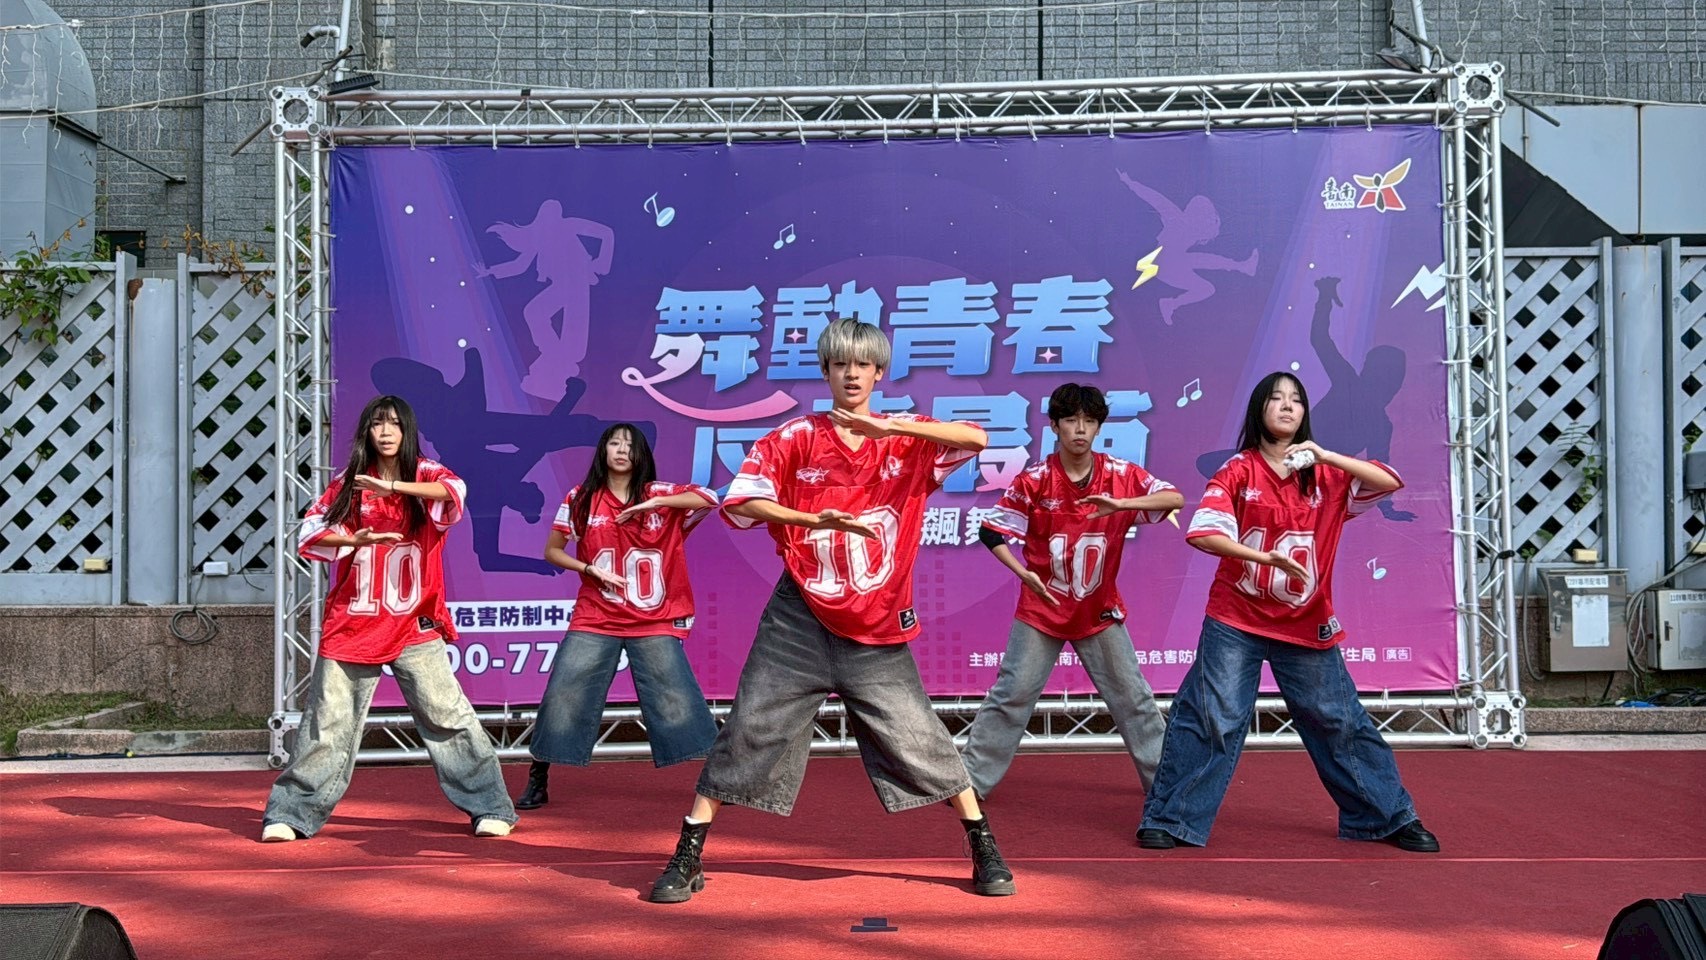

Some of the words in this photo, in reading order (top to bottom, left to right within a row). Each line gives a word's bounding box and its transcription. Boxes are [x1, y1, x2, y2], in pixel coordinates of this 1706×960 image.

[622, 275, 1114, 422] 舞動青春
[347, 540, 423, 617] 10
[592, 547, 667, 611] 10
[804, 505, 900, 599] 10
[1047, 532, 1107, 602] 10
[1235, 526, 1319, 609] 10
[447, 606, 573, 627] 危害防制中
[969, 652, 1005, 667] 主辦
[1135, 650, 1197, 665] 品危害防
